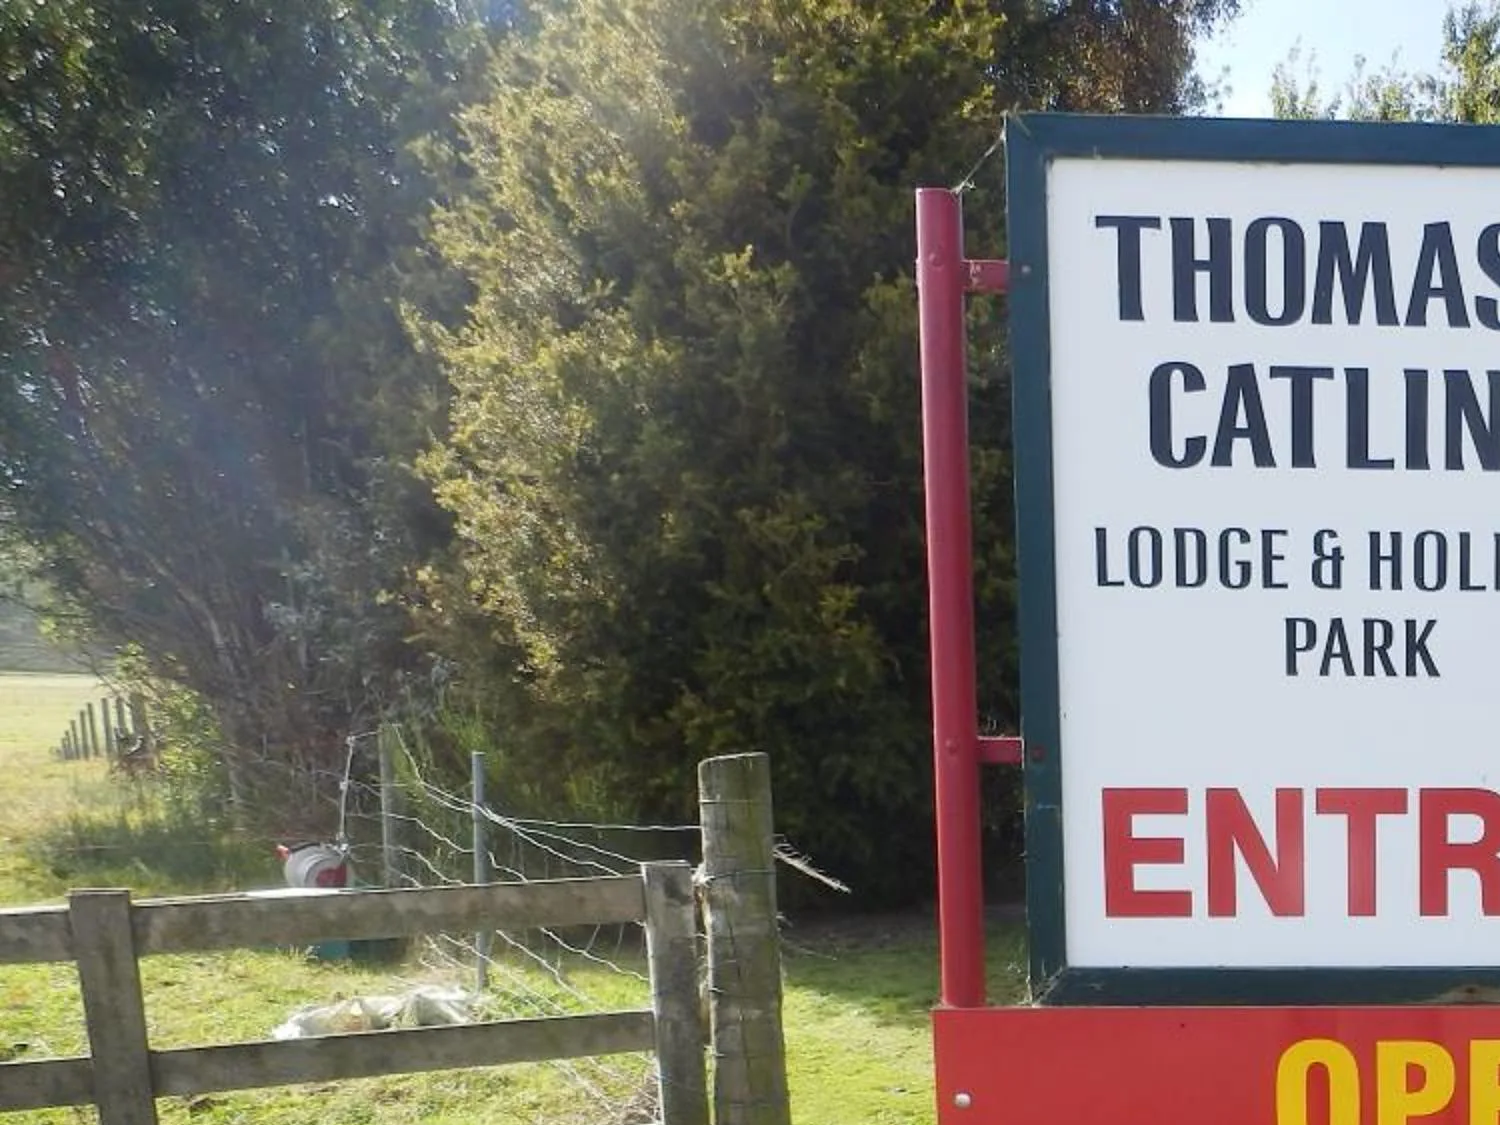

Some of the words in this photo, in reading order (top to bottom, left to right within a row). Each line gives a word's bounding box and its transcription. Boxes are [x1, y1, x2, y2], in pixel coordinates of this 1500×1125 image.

[1095, 526, 1289, 590] LODGE
[1311, 529, 1344, 591] &
[1285, 617, 1441, 678] PARK
